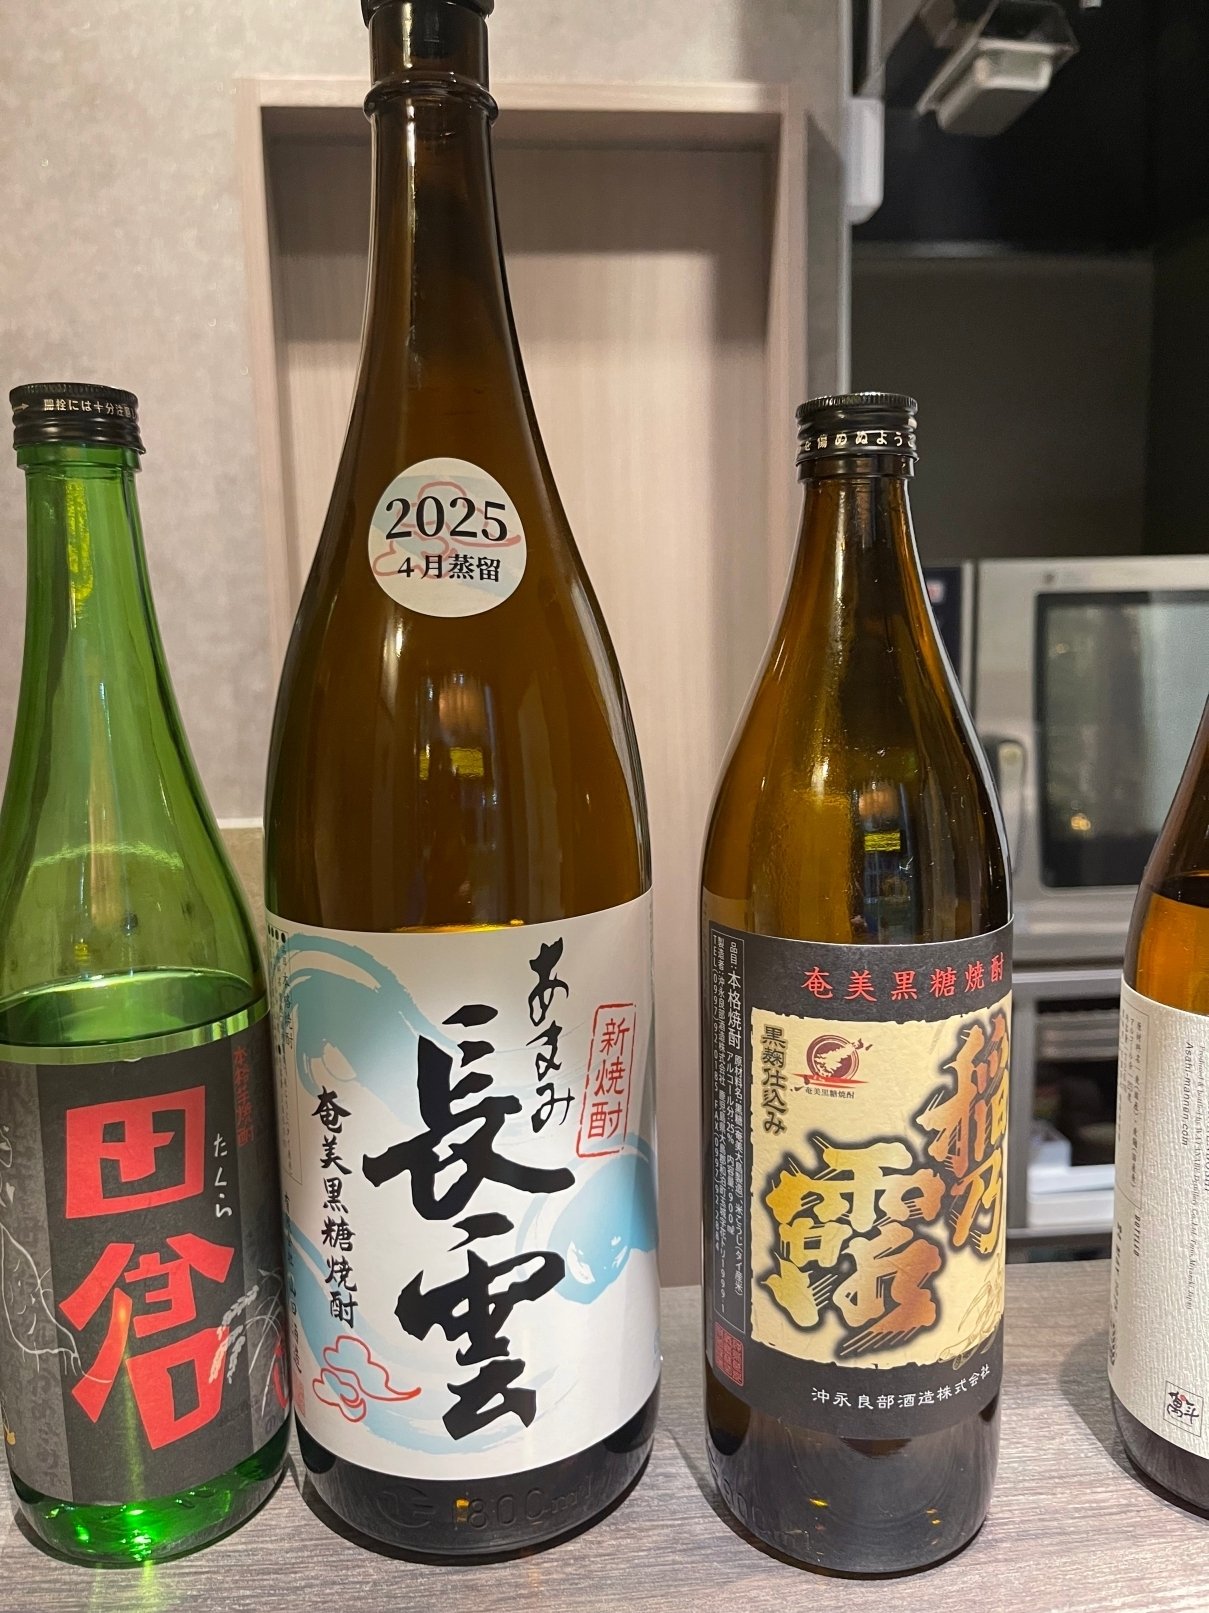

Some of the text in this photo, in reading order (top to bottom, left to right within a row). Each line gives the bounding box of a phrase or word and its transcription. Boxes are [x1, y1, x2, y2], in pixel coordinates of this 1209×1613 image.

[385, 495, 508, 542] 2025
[397, 553, 502, 583] 4月蒸留
[800, 950, 1005, 1003] 奄美黒糖焼酎
[526, 936, 576, 1134] あまみ
[586, 1015, 631, 1140] 新焼酎
[760, 1023, 787, 1136] 黒麹仕込み
[1181, 1041, 1194, 1146] Asahi-mannen.com
[311, 1085, 358, 1329] 奄美黒糖焼酎
[362, 1003, 576, 1441] 長雲
[811, 1363, 991, 1410] 沖永良部酒造株式会社
